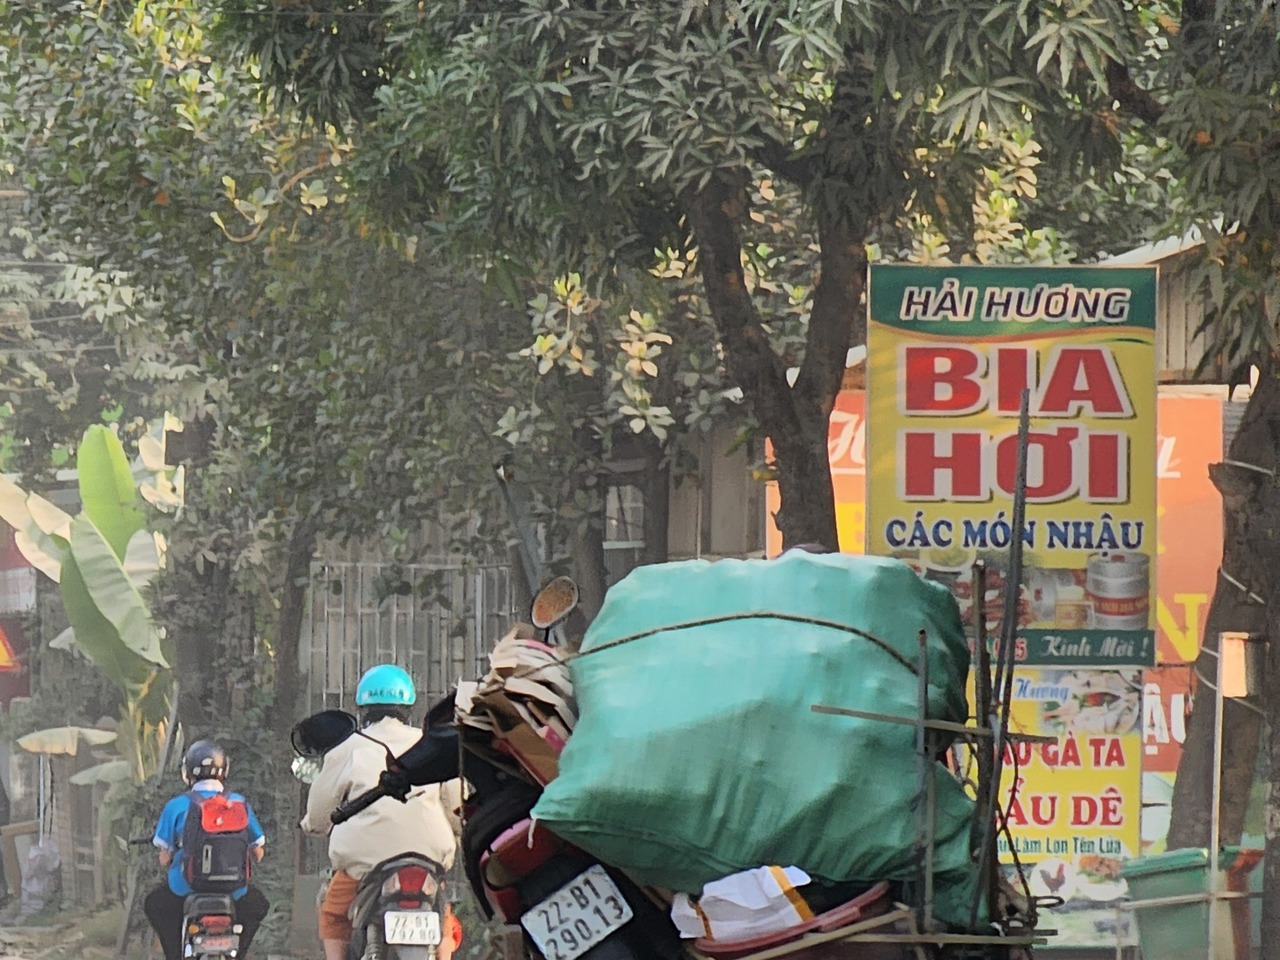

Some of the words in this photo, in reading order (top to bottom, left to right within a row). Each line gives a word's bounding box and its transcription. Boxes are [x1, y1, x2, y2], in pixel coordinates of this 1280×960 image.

[902, 279, 977, 320] HẢI
[984, 284, 1130, 321] HƯƠNG
[903, 345, 1127, 414] BIA
[903, 426, 1121, 500] HƠI
[885, 511, 953, 549] CÁC
[963, 511, 1037, 549] MÓN
[1046, 512, 1145, 558] NHẬU
[1089, 737, 1126, 768] TA
[1071, 786, 1124, 827] DÊ
